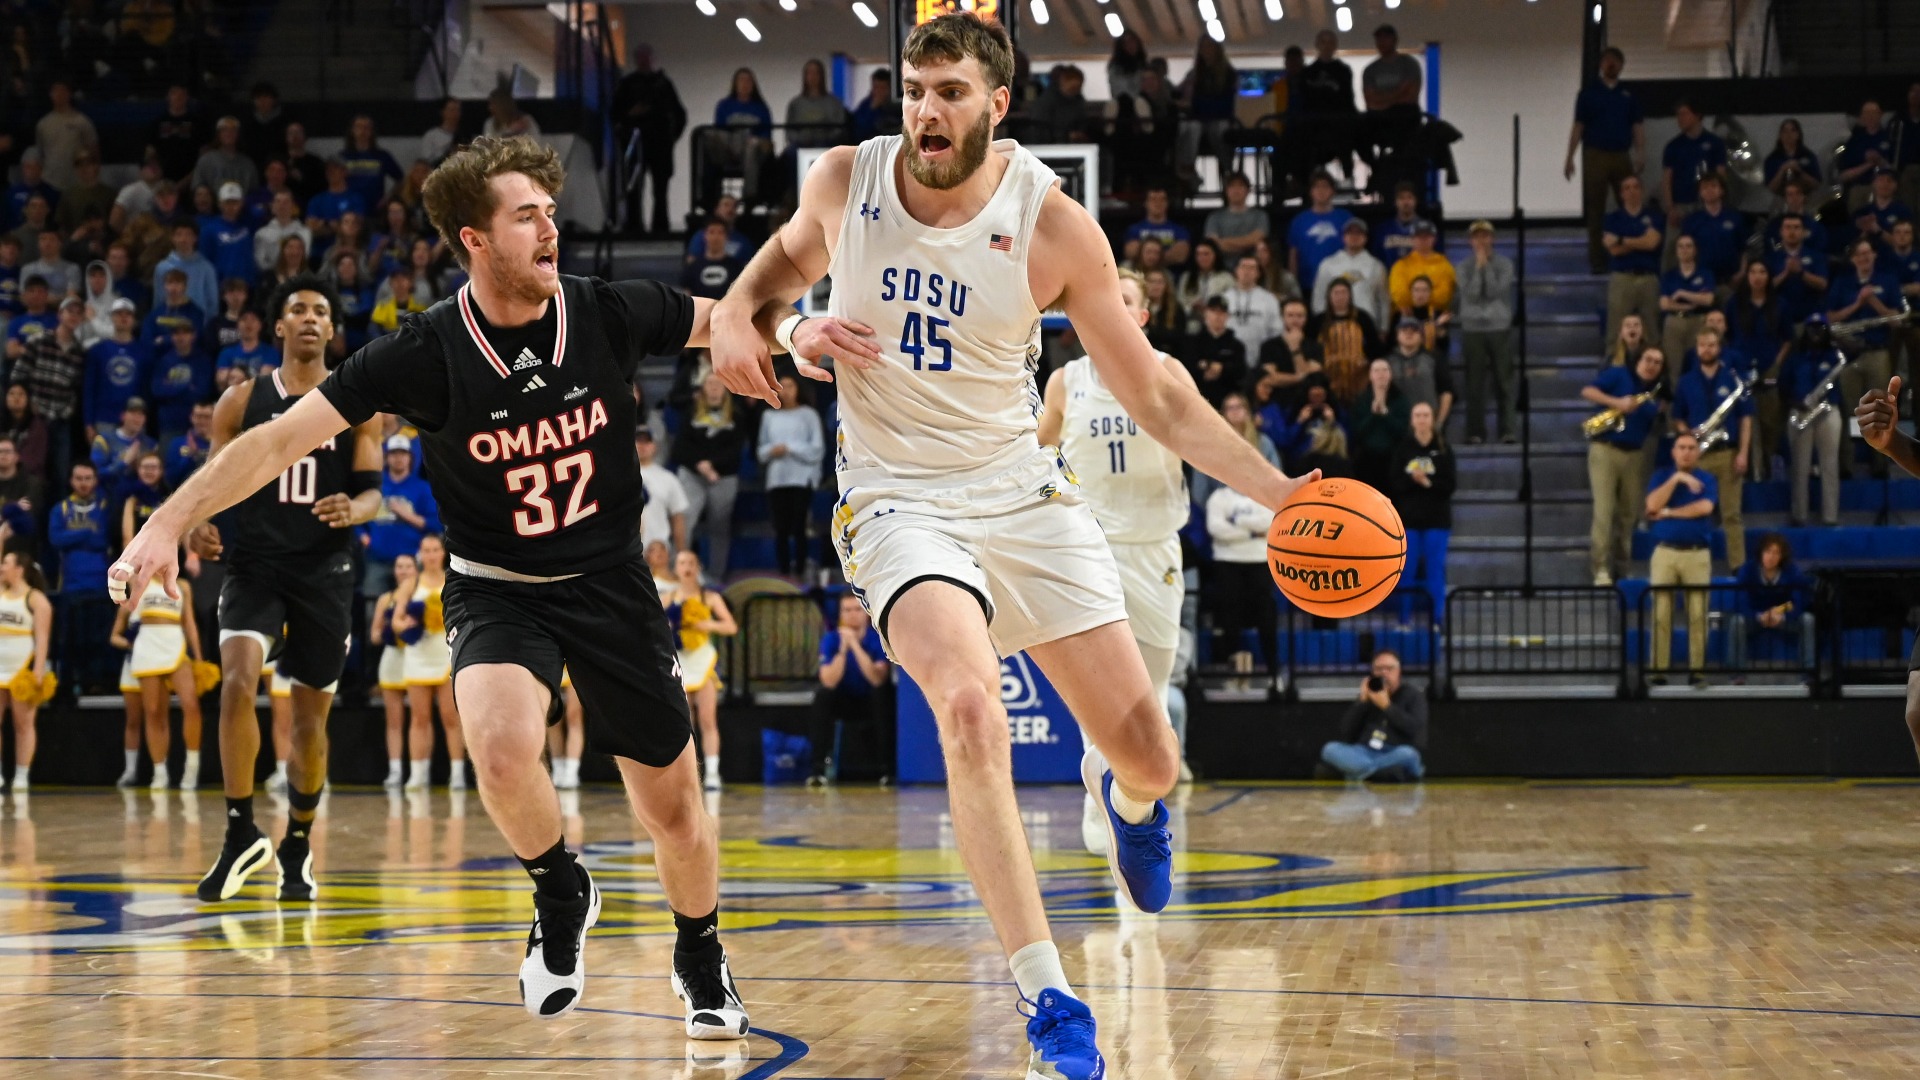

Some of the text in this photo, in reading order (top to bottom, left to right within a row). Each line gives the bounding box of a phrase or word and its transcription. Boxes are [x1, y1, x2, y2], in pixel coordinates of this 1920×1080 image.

[882, 267, 967, 317] SDSU
[900, 311, 952, 372] 45
[513, 358, 543, 371] adidas
[467, 398, 609, 463] OMAHA
[491, 409, 508, 420] HH
[1090, 416, 1137, 438] SDSU
[1108, 440, 1126, 474] 11
[278, 455, 317, 504] 10
[504, 449, 599, 538] 32
[1289, 518, 1345, 540] EVO
[1274, 558, 1362, 592] Wilson
